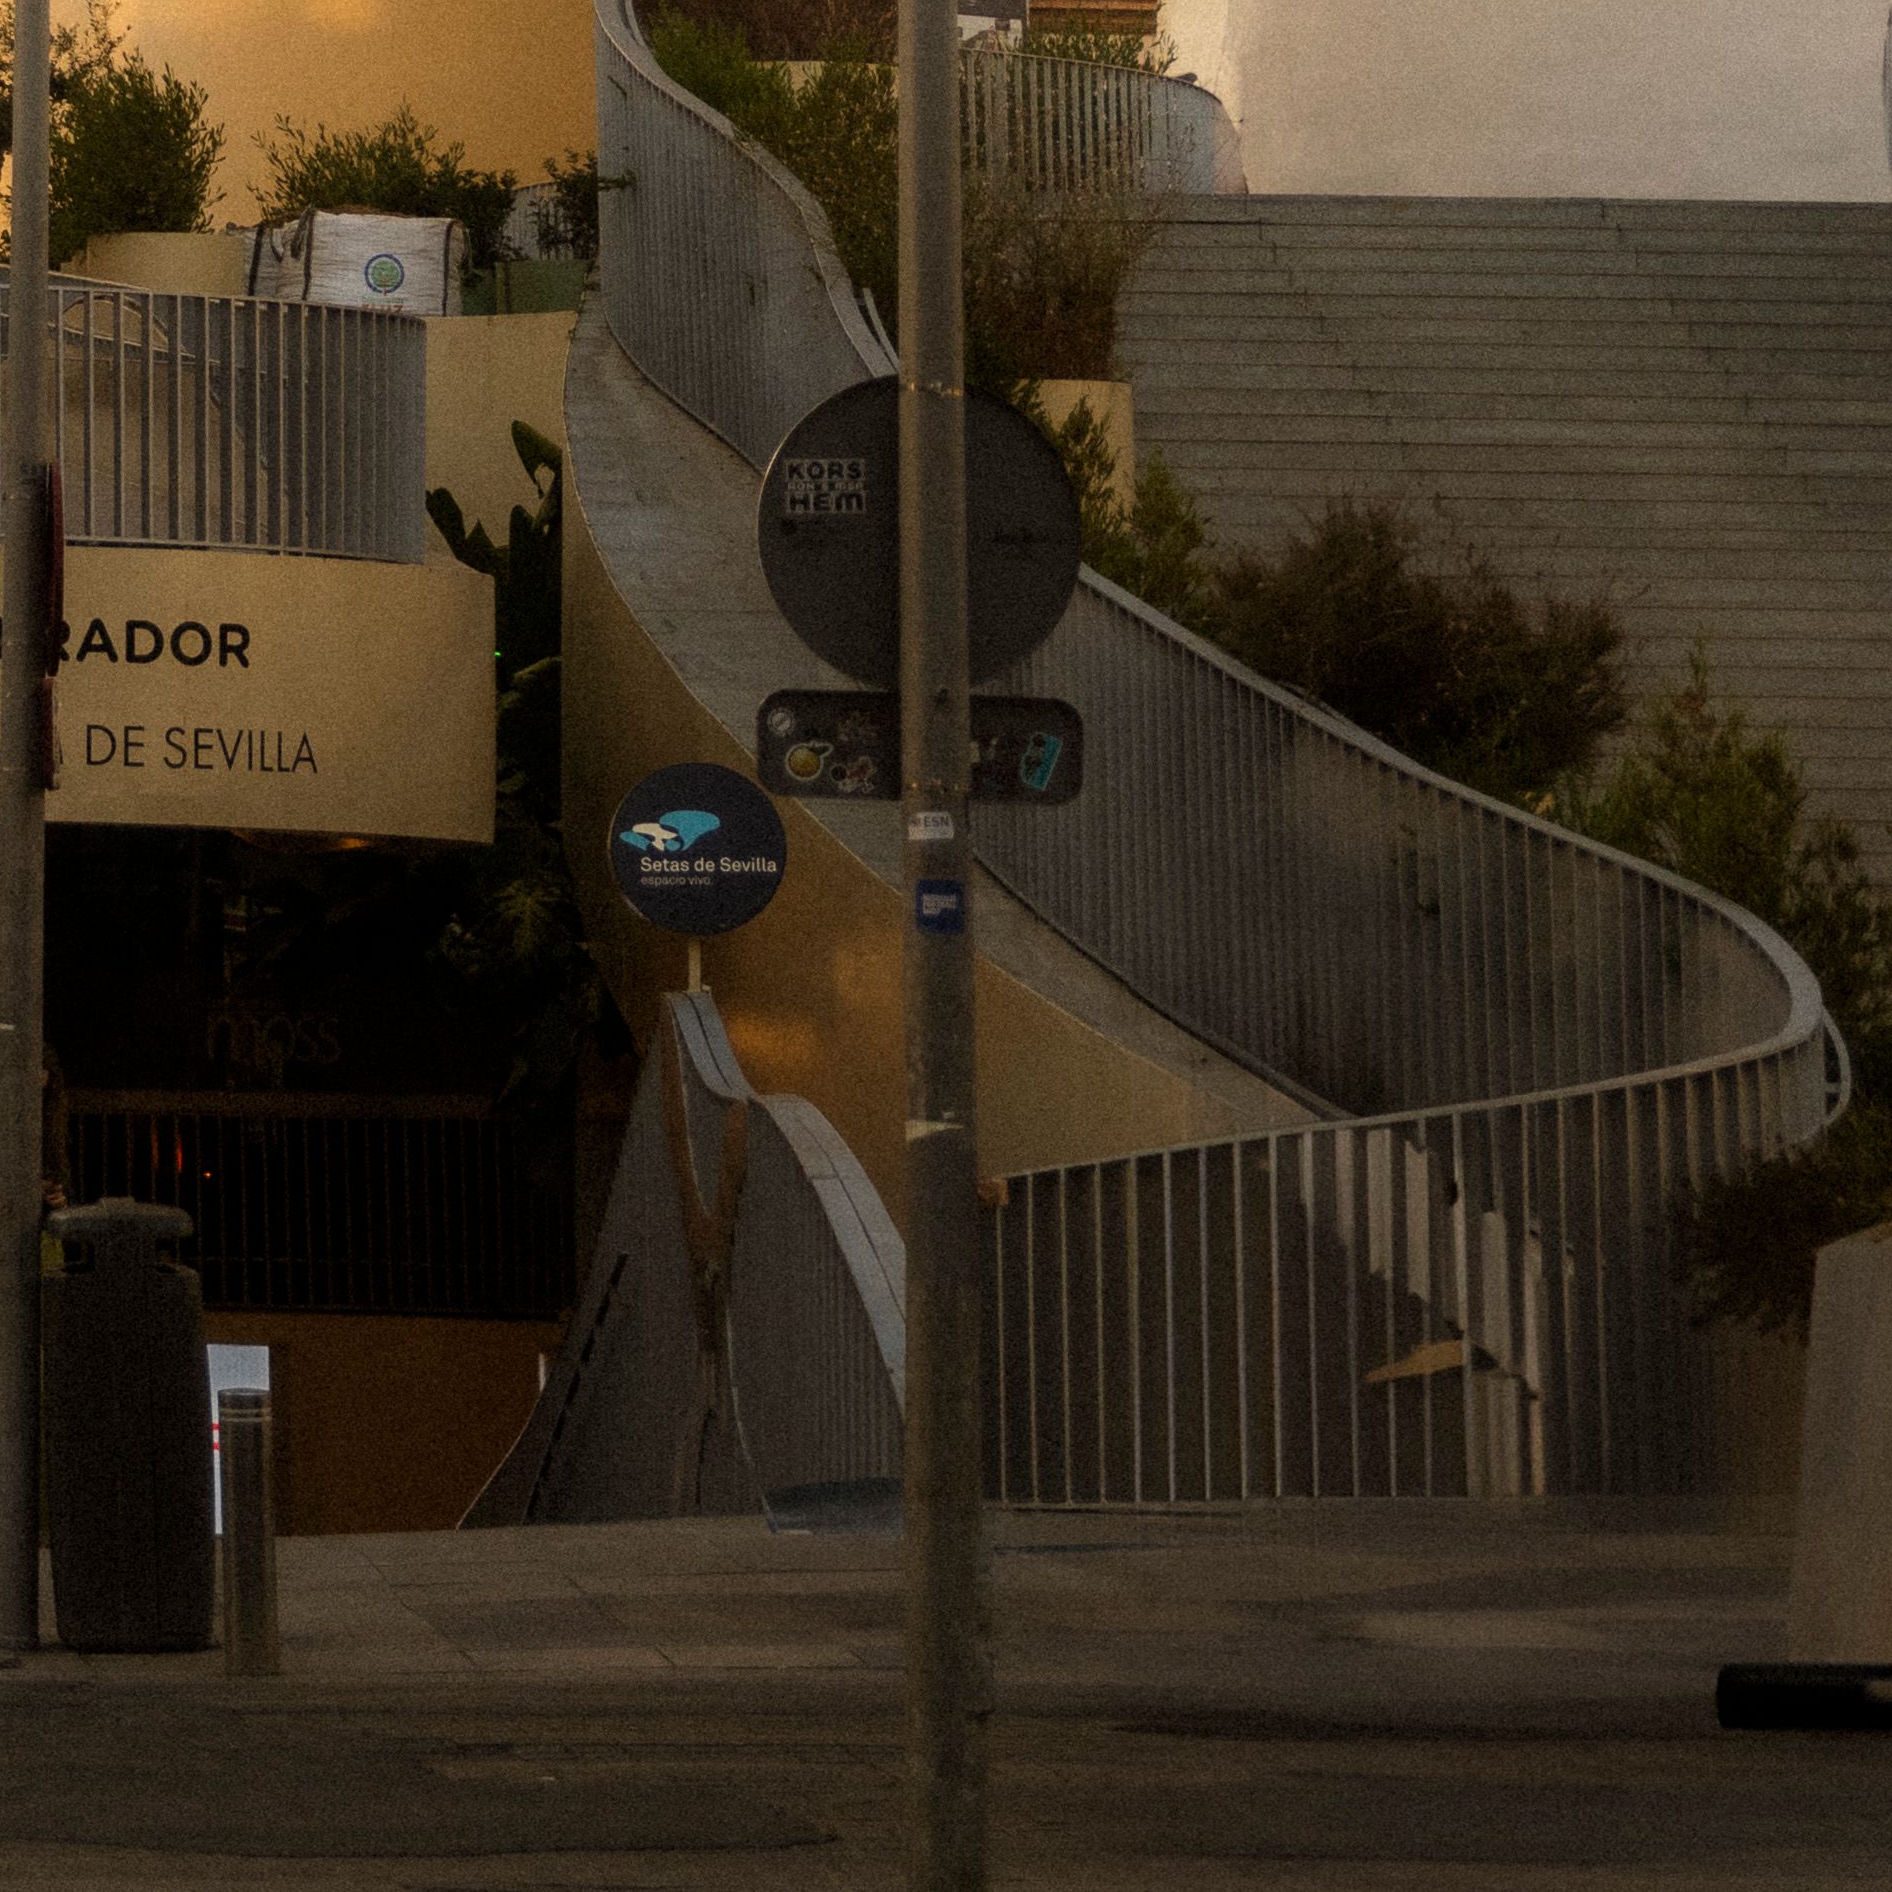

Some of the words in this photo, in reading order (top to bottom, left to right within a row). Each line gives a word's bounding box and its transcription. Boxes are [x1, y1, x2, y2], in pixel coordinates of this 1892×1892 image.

[787, 460, 862, 480] KORS
[84, 724, 146, 768] DE
[162, 725, 319, 775] SEVILLA
[639, 856, 690, 873] Setas
[693, 856, 716, 873] de
[719, 856, 778, 873] Sevilla
[639, 875, 687, 888] espacio
